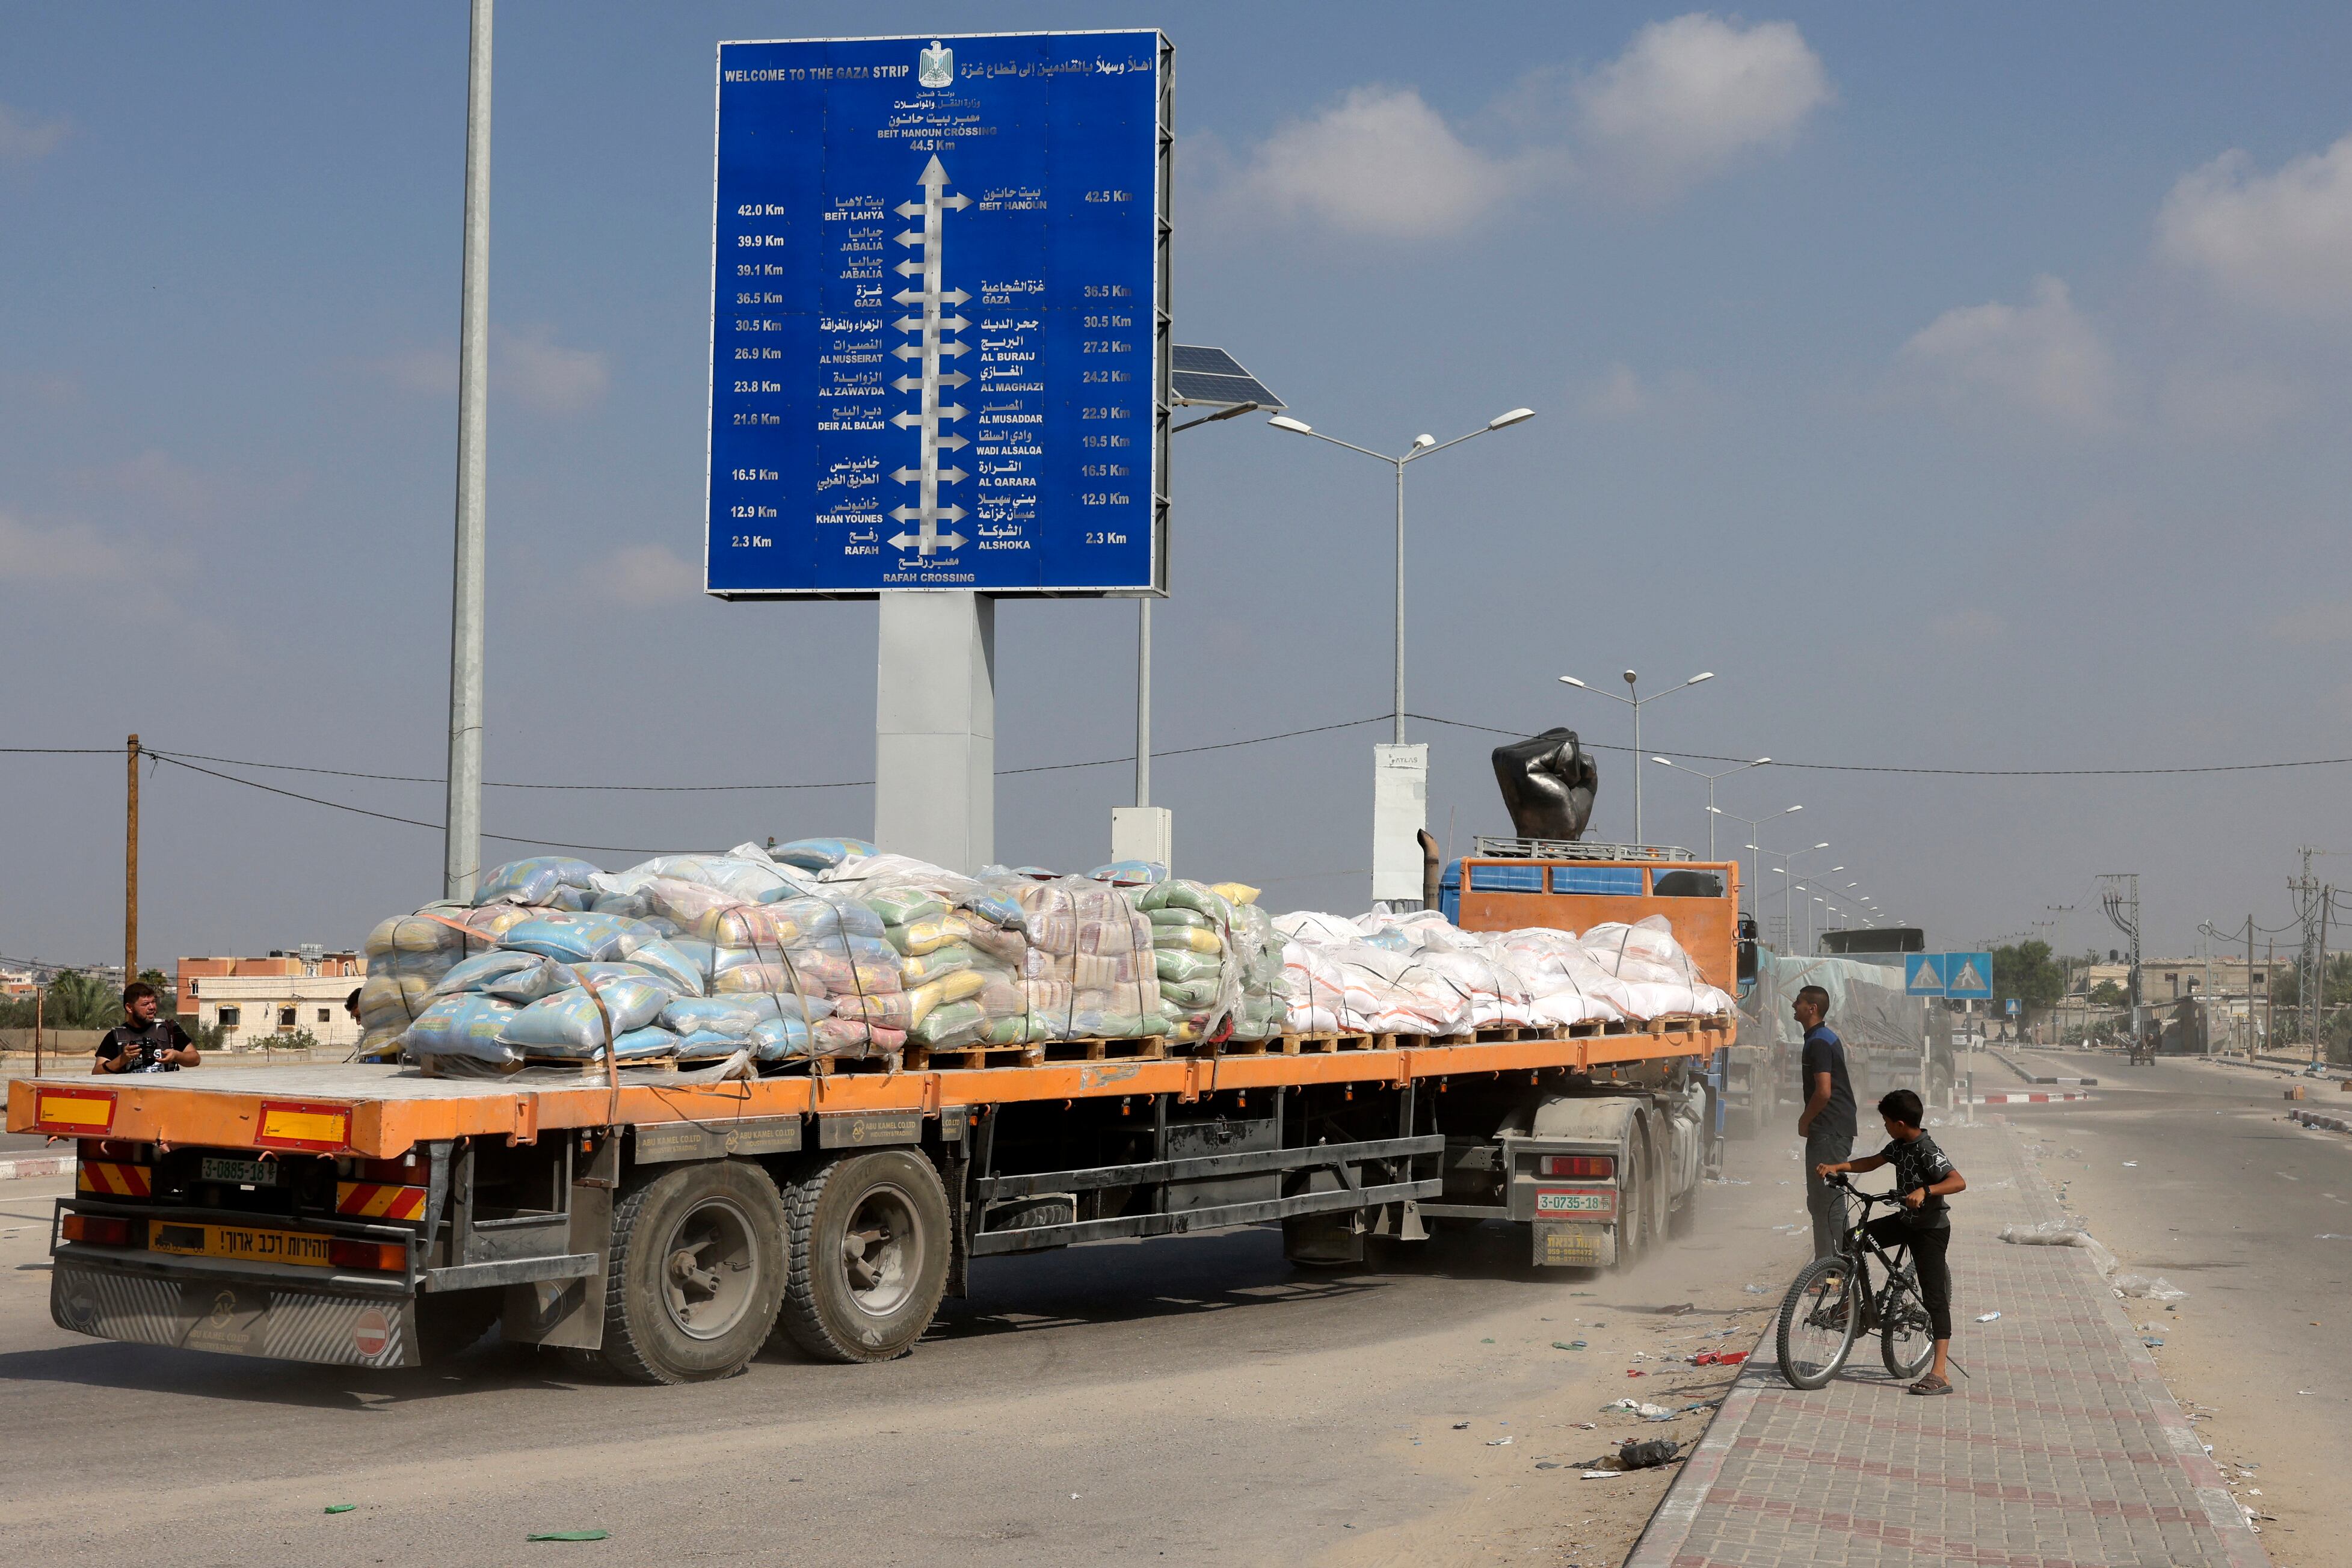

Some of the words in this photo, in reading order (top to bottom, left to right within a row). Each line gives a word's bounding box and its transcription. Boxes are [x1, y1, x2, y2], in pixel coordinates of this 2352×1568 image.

[961, 63, 984, 78] غزة
[987, 61, 1016, 78] قطاع
[1019, 63, 1035, 77] إلى
[1038, 58, 1092, 76] بالقادمين
[725, 69, 784, 82] WELCOME
[789, 69, 805, 80] TO
[810, 68, 833, 79] THE
[837, 67, 869, 78] GAZA
[873, 66, 909, 78] STRIP
[894, 100, 935, 109] والمواصلات
[964, 99, 980, 107] وزارة
[888, 113, 923, 127] حانون
[926, 114, 950, 126] بيت
[952, 115, 979, 126] معبر
[878, 128, 899, 138] BEIT
[902, 129, 941, 137] HANOUN
[944, 126, 996, 136] CROSSING
[910, 140, 934, 150] 44.5
[937, 140, 955, 150] Km
[984, 188, 1016, 201] حانون
[1019, 187, 1040, 200] بيت
[1085, 191, 1109, 202] 42.5
[1113, 190, 1131, 201] Km
[836, 196, 863, 212] لاهيا
[865, 195, 884, 210] بيت
[979, 202, 1002, 211] BEIT
[1005, 201, 1047, 209] HANOUN
[738, 204, 762, 216] 42.0
[766, 204, 784, 215] Km
[824, 211, 848, 221] BEIT
[851, 211, 884, 221] LAHYA
[849, 227, 883, 242] جباليا
[738, 236, 762, 247] 39.9
[766, 235, 784, 246] Km
[840, 241, 883, 251] JABALIA
[849, 256, 882, 270] جباليا
[737, 265, 760, 275] 39.1
[765, 264, 783, 275] Km
[840, 269, 882, 278] JABALIA
[857, 284, 882, 298] غزة
[982, 280, 1026, 295] الشجاعية
[1027, 280, 1045, 294] غزة
[1085, 286, 1109, 297] 36.5
[1113, 285, 1131, 297] Km
[737, 293, 760, 304] 36.5
[764, 292, 782, 303] Km
[854, 299, 882, 307] GAZA
[736, 320, 759, 331] 30.5
[763, 320, 781, 331] Km
[820, 318, 853, 333] والمغراقة
[855, 319, 882, 332] الزهراء
[981, 318, 1012, 332] الديك
[1014, 321, 1038, 331] جحر
[1084, 316, 1108, 327] 30.5
[1112, 316, 1131, 327] Km
[834, 339, 881, 354] النصيرات
[981, 336, 1023, 351] البريج
[1084, 342, 1108, 353] 27.2
[1112, 341, 1131, 352] Km
[735, 348, 759, 359] 26.9
[763, 348, 781, 359] Km
[833, 354, 883, 363] NUSSEIRAT
[981, 353, 994, 361] AL
[997, 352, 1035, 361] BURAIJ
[981, 365, 1023, 381] المغازي
[1083, 371, 1108, 383] 24.2
[1112, 370, 1130, 382] Km
[834, 372, 881, 387] الزوايدة
[734, 381, 758, 392] 23.8
[762, 381, 780, 392] Km
[819, 387, 833, 396] AL
[834, 387, 885, 395] ZAWAYDA
[996, 383, 1044, 392] MAGHAZI
[833, 405, 859, 420] البلح
[861, 407, 881, 419] دير
[980, 400, 1022, 414] المصدر
[1083, 408, 1107, 419] 22.9
[1111, 407, 1130, 419] Km
[734, 414, 757, 425] 21.6
[762, 413, 780, 424] Km
[993, 414, 1042, 423] MUSADDAR
[841, 422, 853, 430] AL
[854, 421, 884, 430] BALAH
[979, 429, 1008, 441] السلقا
[1011, 430, 1032, 444] وادي
[1083, 436, 1107, 447] 19.5
[1111, 435, 1130, 447] Km
[1001, 446, 1042, 455] ALSALQA
[830, 456, 879, 473] خانيونس
[979, 460, 1021, 475] القرارة
[1082, 465, 1106, 476] 16.5
[1110, 464, 1129, 476] Km
[732, 469, 756, 480] 16.5
[760, 469, 778, 480] Km
[847, 473, 879, 488] الطريق
[817, 474, 845, 491] الغربي
[994, 478, 1036, 487] QARARA
[977, 493, 1011, 509] سهيلا
[1012, 494, 1036, 508] بني
[1082, 493, 1106, 505] 12.9
[1110, 493, 1129, 504] Km
[731, 506, 754, 517] 12.9
[758, 506, 777, 517] Km
[831, 497, 879, 514] خانيونس
[816, 515, 843, 523] KHAN
[845, 514, 883, 523] YOUNES
[977, 507, 1006, 521] خزاعة
[849, 527, 878, 544] رفح
[977, 524, 1021, 539] الشوكة
[732, 536, 749, 547] 2.3
[753, 536, 771, 547] Km
[1086, 532, 1103, 544] 2.3
[1107, 532, 1126, 544] Km
[845, 546, 878, 555] RAFAH
[979, 541, 1030, 549] ALSHOKA
[899, 554, 929, 570] رفح
[928, 558, 959, 569] معبر
[884, 573, 917, 582] RAFAH
[920, 573, 974, 582] CROSSING
[753, 1130, 774, 1139] KAMEL
[775, 1128, 795, 1137] CO.LTD
[657, 1136, 679, 1145] KAMEL
[206, 1160, 264, 1181] 3-0885-18
[1541, 1196, 1599, 1209] 3-0735-18
[221, 1231, 253, 1253] ארוך!
[259, 1234, 282, 1255] רכב
[288, 1237, 328, 1258] זהירות
[203, 1331, 225, 1341] KAMEL
